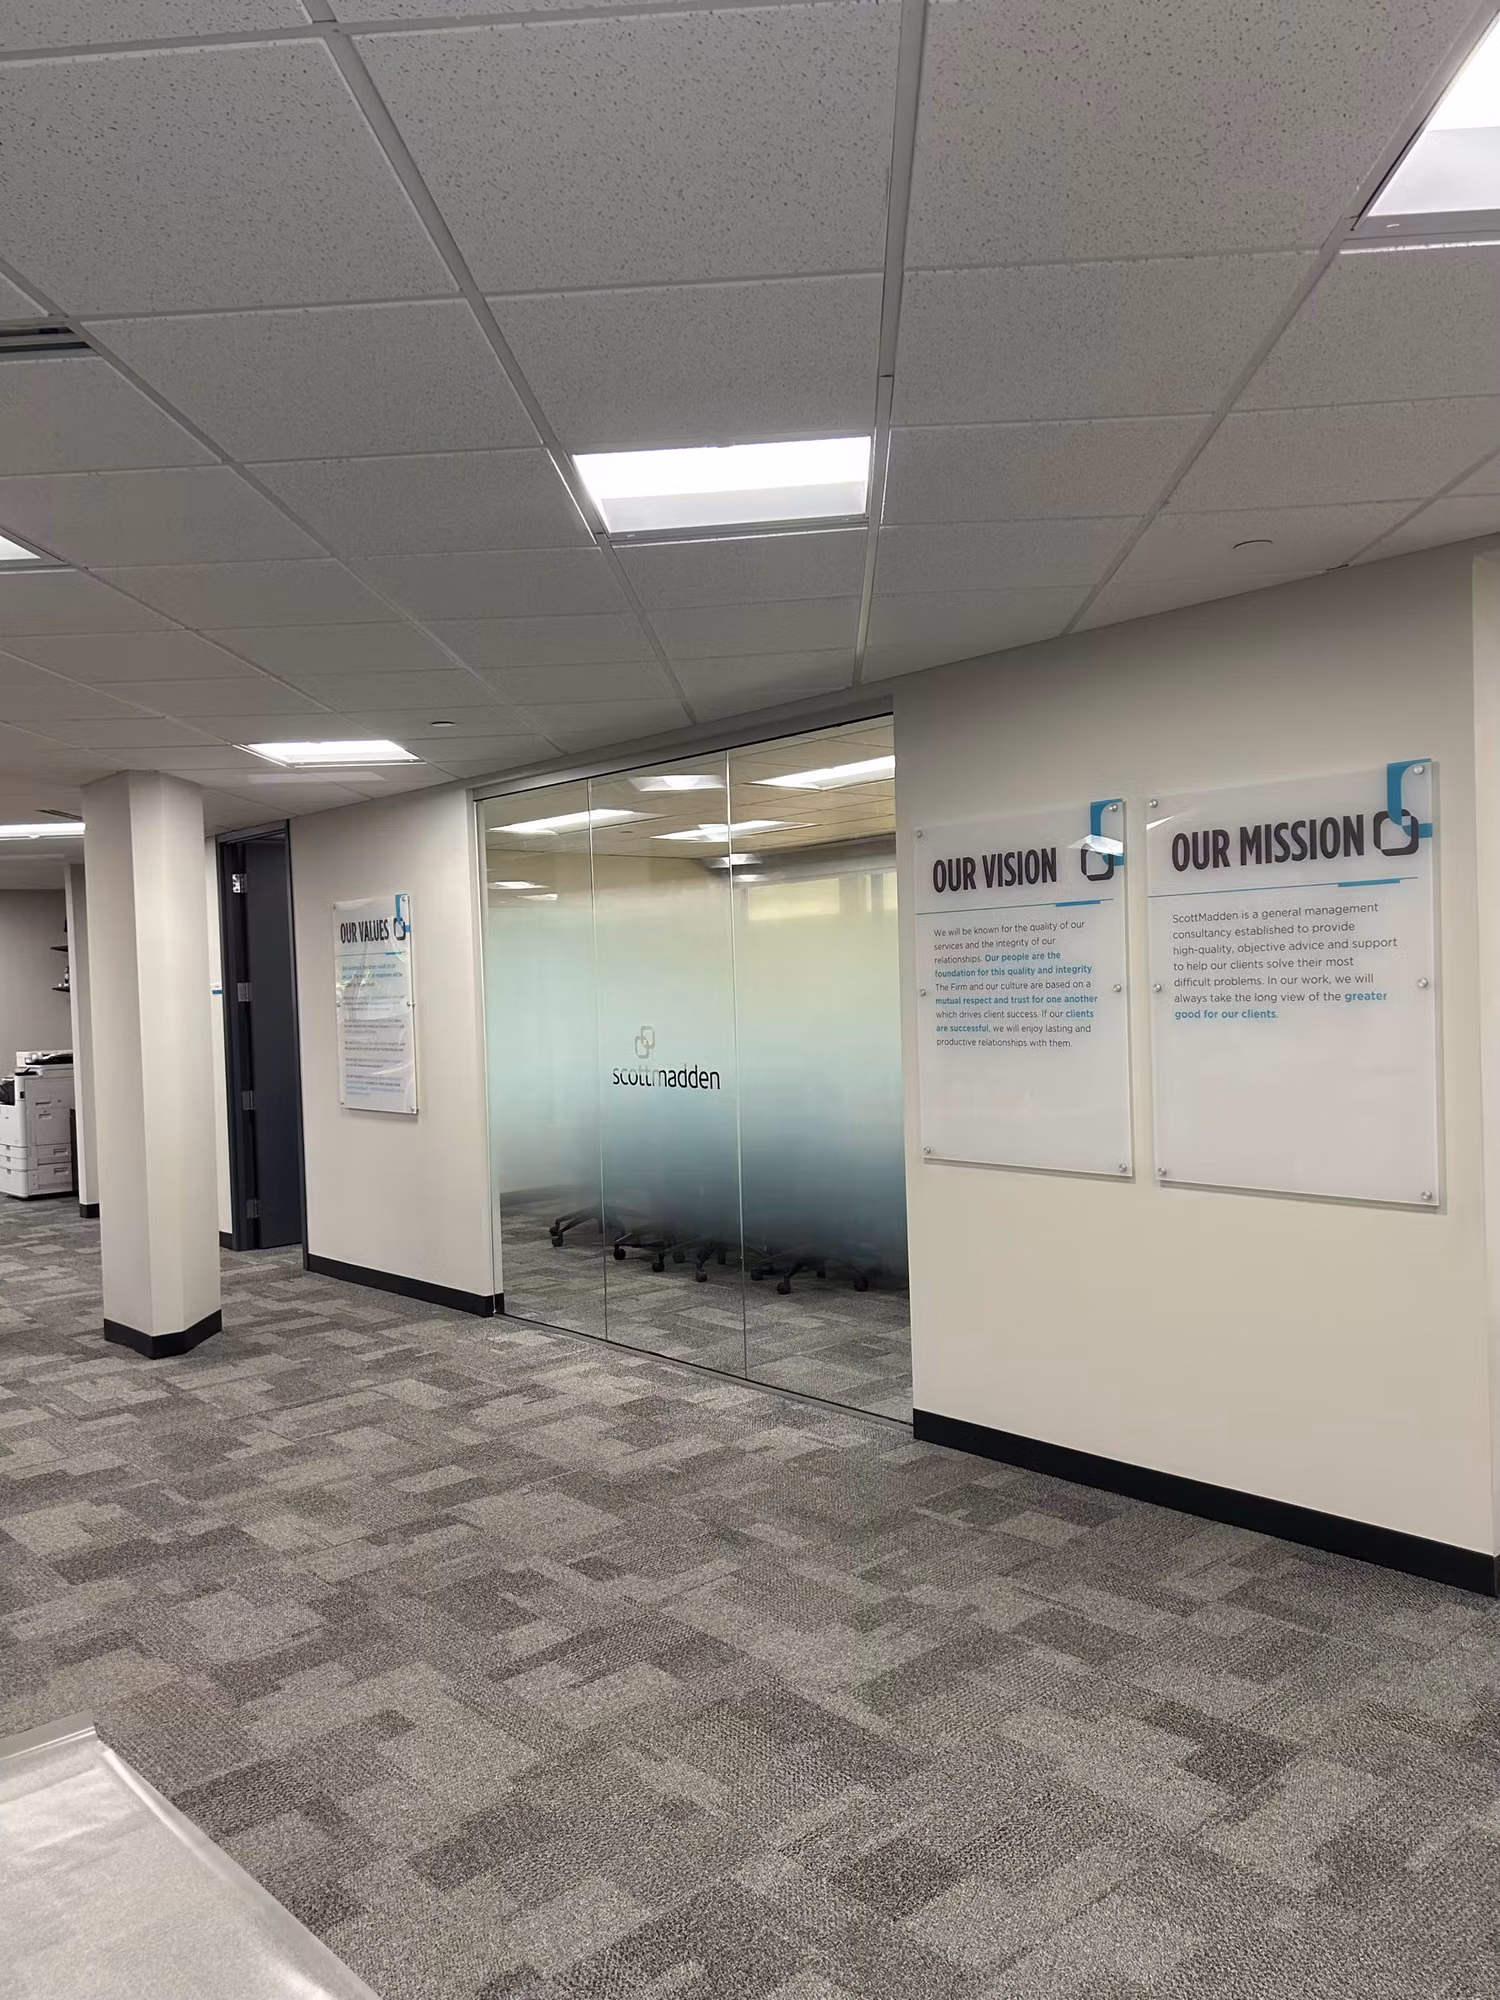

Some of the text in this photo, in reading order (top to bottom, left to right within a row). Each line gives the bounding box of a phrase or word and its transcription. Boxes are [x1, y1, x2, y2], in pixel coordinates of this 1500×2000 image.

[1171, 814, 1365, 872] OUR MISSION
[932, 847, 1057, 893] OUR VISION
[1173, 912, 1238, 923] ScottMadden
[1262, 908, 1301, 920] general
[1304, 903, 1378, 916] management
[340, 919, 390, 944] OUR VALUES
[1030, 922, 1057, 932] quality
[1173, 922, 1355, 940] consultancy established to provide
[934, 942, 963, 950] services
[996, 938, 1028, 947] integrity
[1173, 938, 1398, 956] high-quality, objective advice and support
[1002, 953, 1029, 962] people
[1174, 962, 1184, 971] to
[1186, 961, 1208, 972] help
[1230, 959, 1263, 969] clients
[1266, 958, 1294, 968] solve
[1297, 957, 1322, 967] their
[1326, 956, 1354, 966] most
[935, 969, 976, 977] foundation
[1008, 967, 1035, 976] quality
[1056, 966, 1092, 974] integrity
[1045, 980, 1070, 988] based
[1174, 977, 1211, 987] difficult
[1214, 976, 1264, 988] problems.
[1268, 976, 1277, 985] In
[1280, 976, 1297, 984] our
[1301, 974, 1332, 985] work,
[1354, 973, 1374, 983] will
[963, 998, 992, 1006] respect
[1175, 991, 1387, 1005] always take the long view of the greater
[1175, 1008, 1279, 1020] good for our clients.
[950, 1024, 990, 1033] successful,
[1021, 1025, 1043, 1034] enjoy
[1045, 1025, 1073, 1034] lasting
[1075, 1024, 1091, 1032] and
[978, 1038, 1027, 1047] relationships
[612, 1064, 720, 1090] scottmadden
